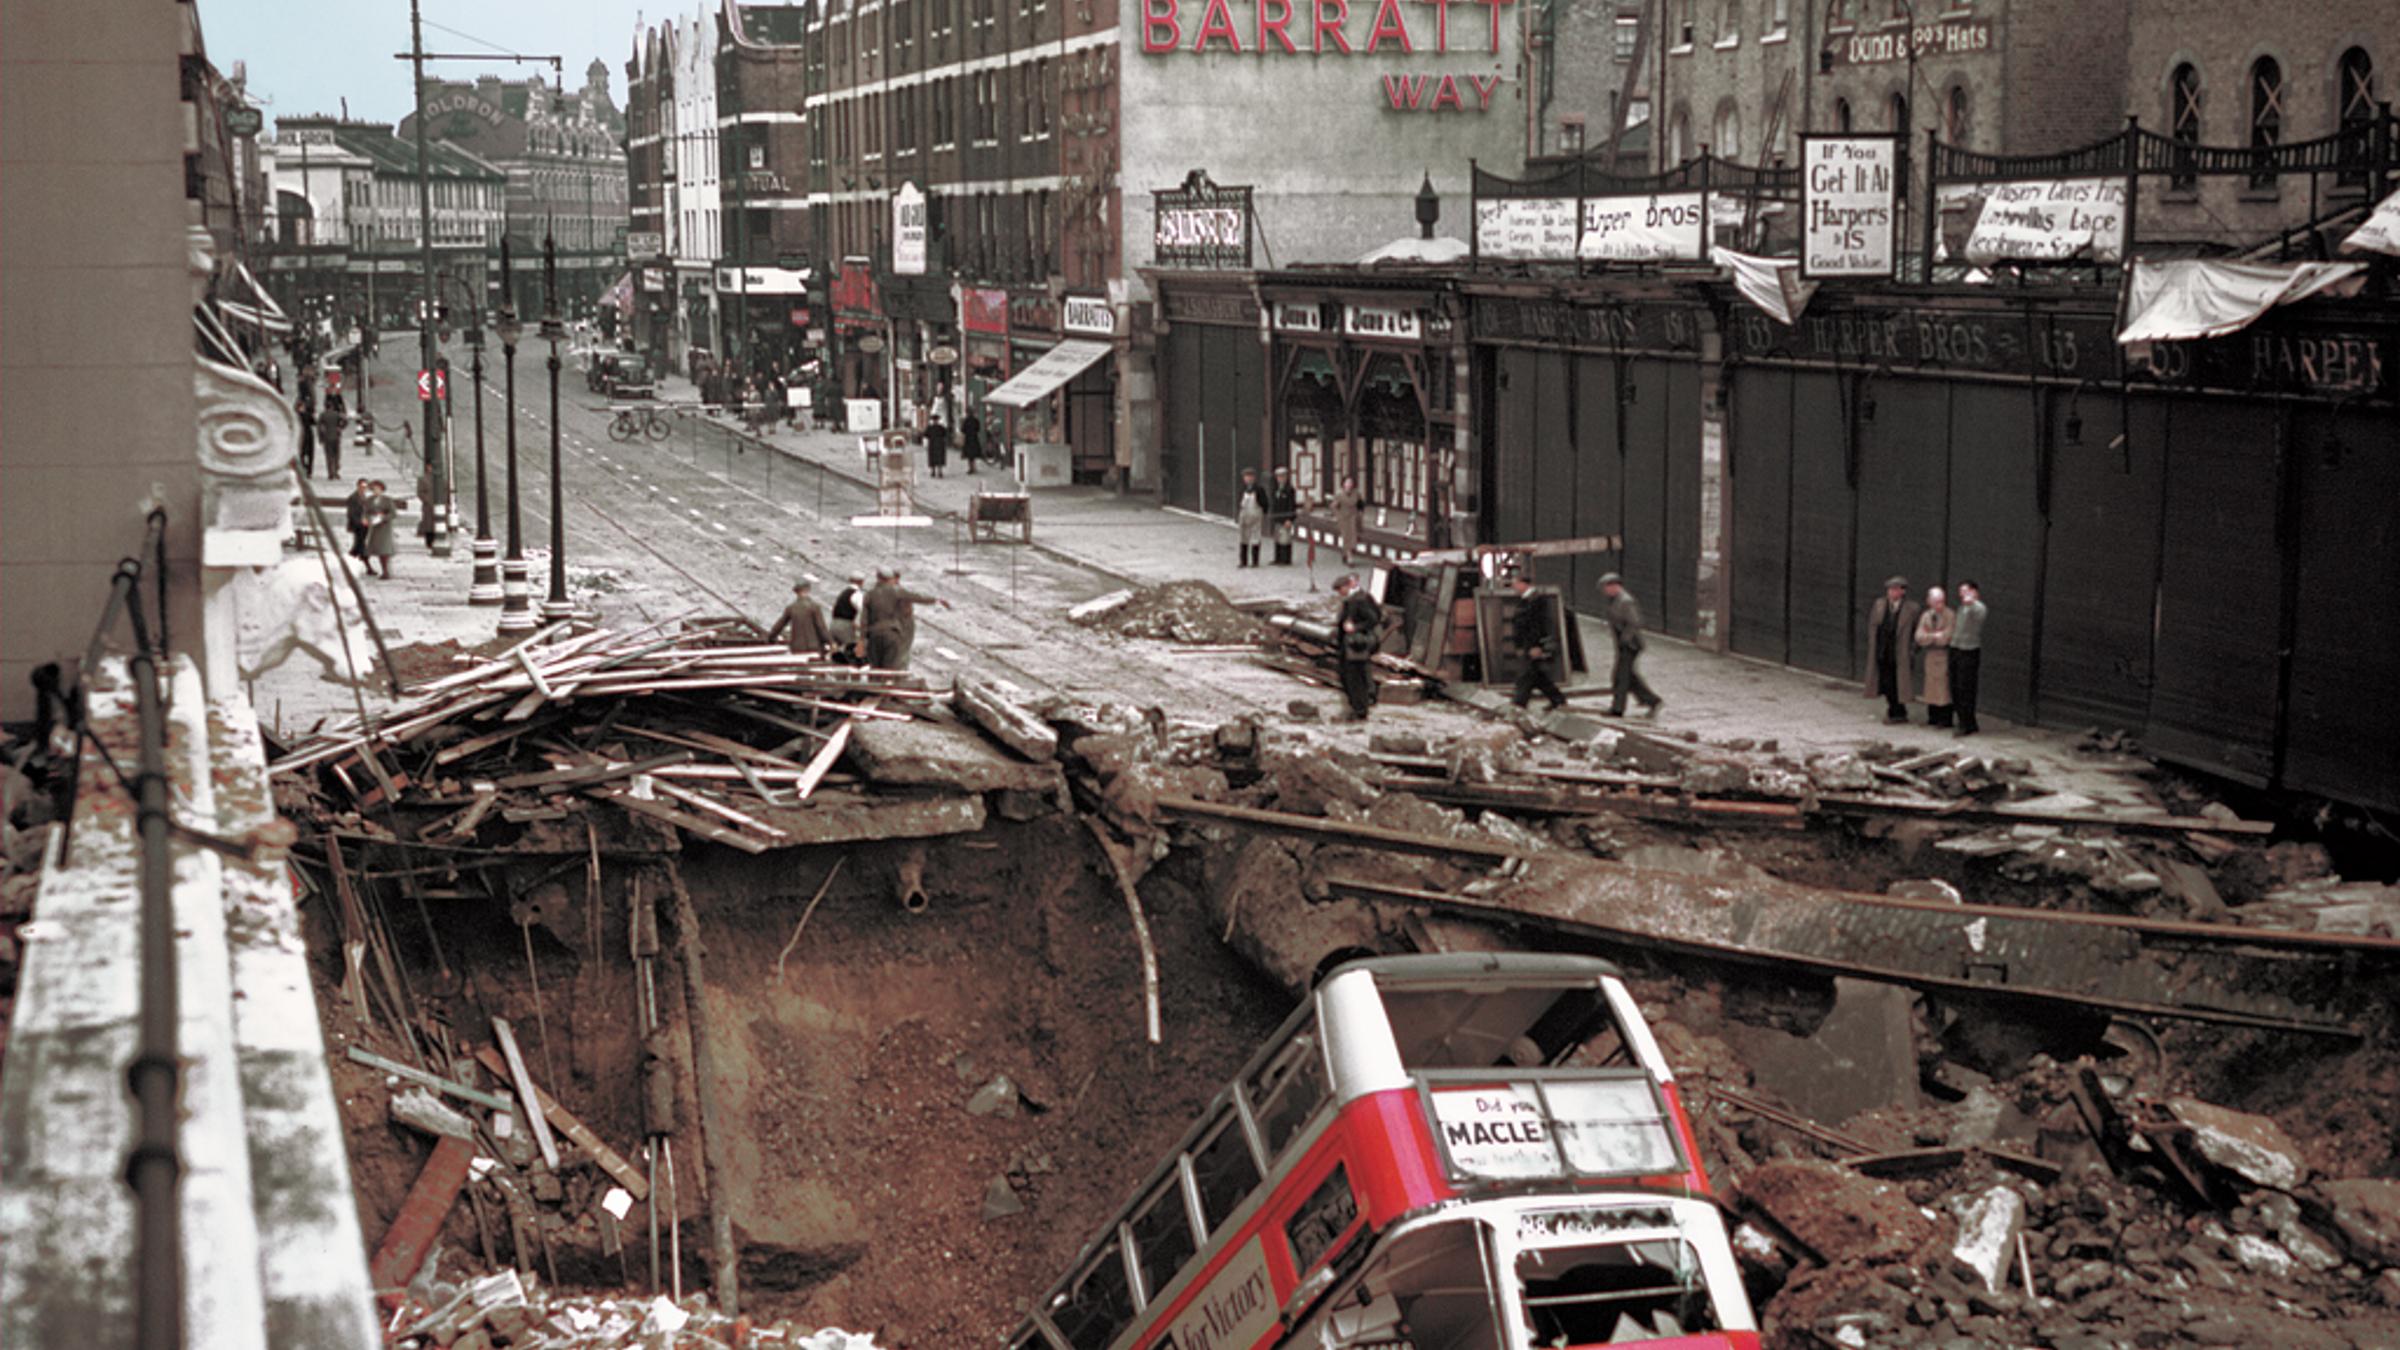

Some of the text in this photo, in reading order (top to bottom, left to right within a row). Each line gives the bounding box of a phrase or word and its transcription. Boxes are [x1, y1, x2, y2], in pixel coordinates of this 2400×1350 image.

[1142, 0, 1502, 54] BARRATT
[1850, 34, 1893, 63] Dunn
[1946, 25, 1987, 51] Hats
[1384, 73, 1501, 110] WAY
[1810, 164, 1846, 193] Get
[2070, 208, 2118, 232] Lace
[1844, 231, 1865, 250] IS
[1919, 320, 1988, 362] BROS
[1202, 1263, 1267, 1341] Victory
